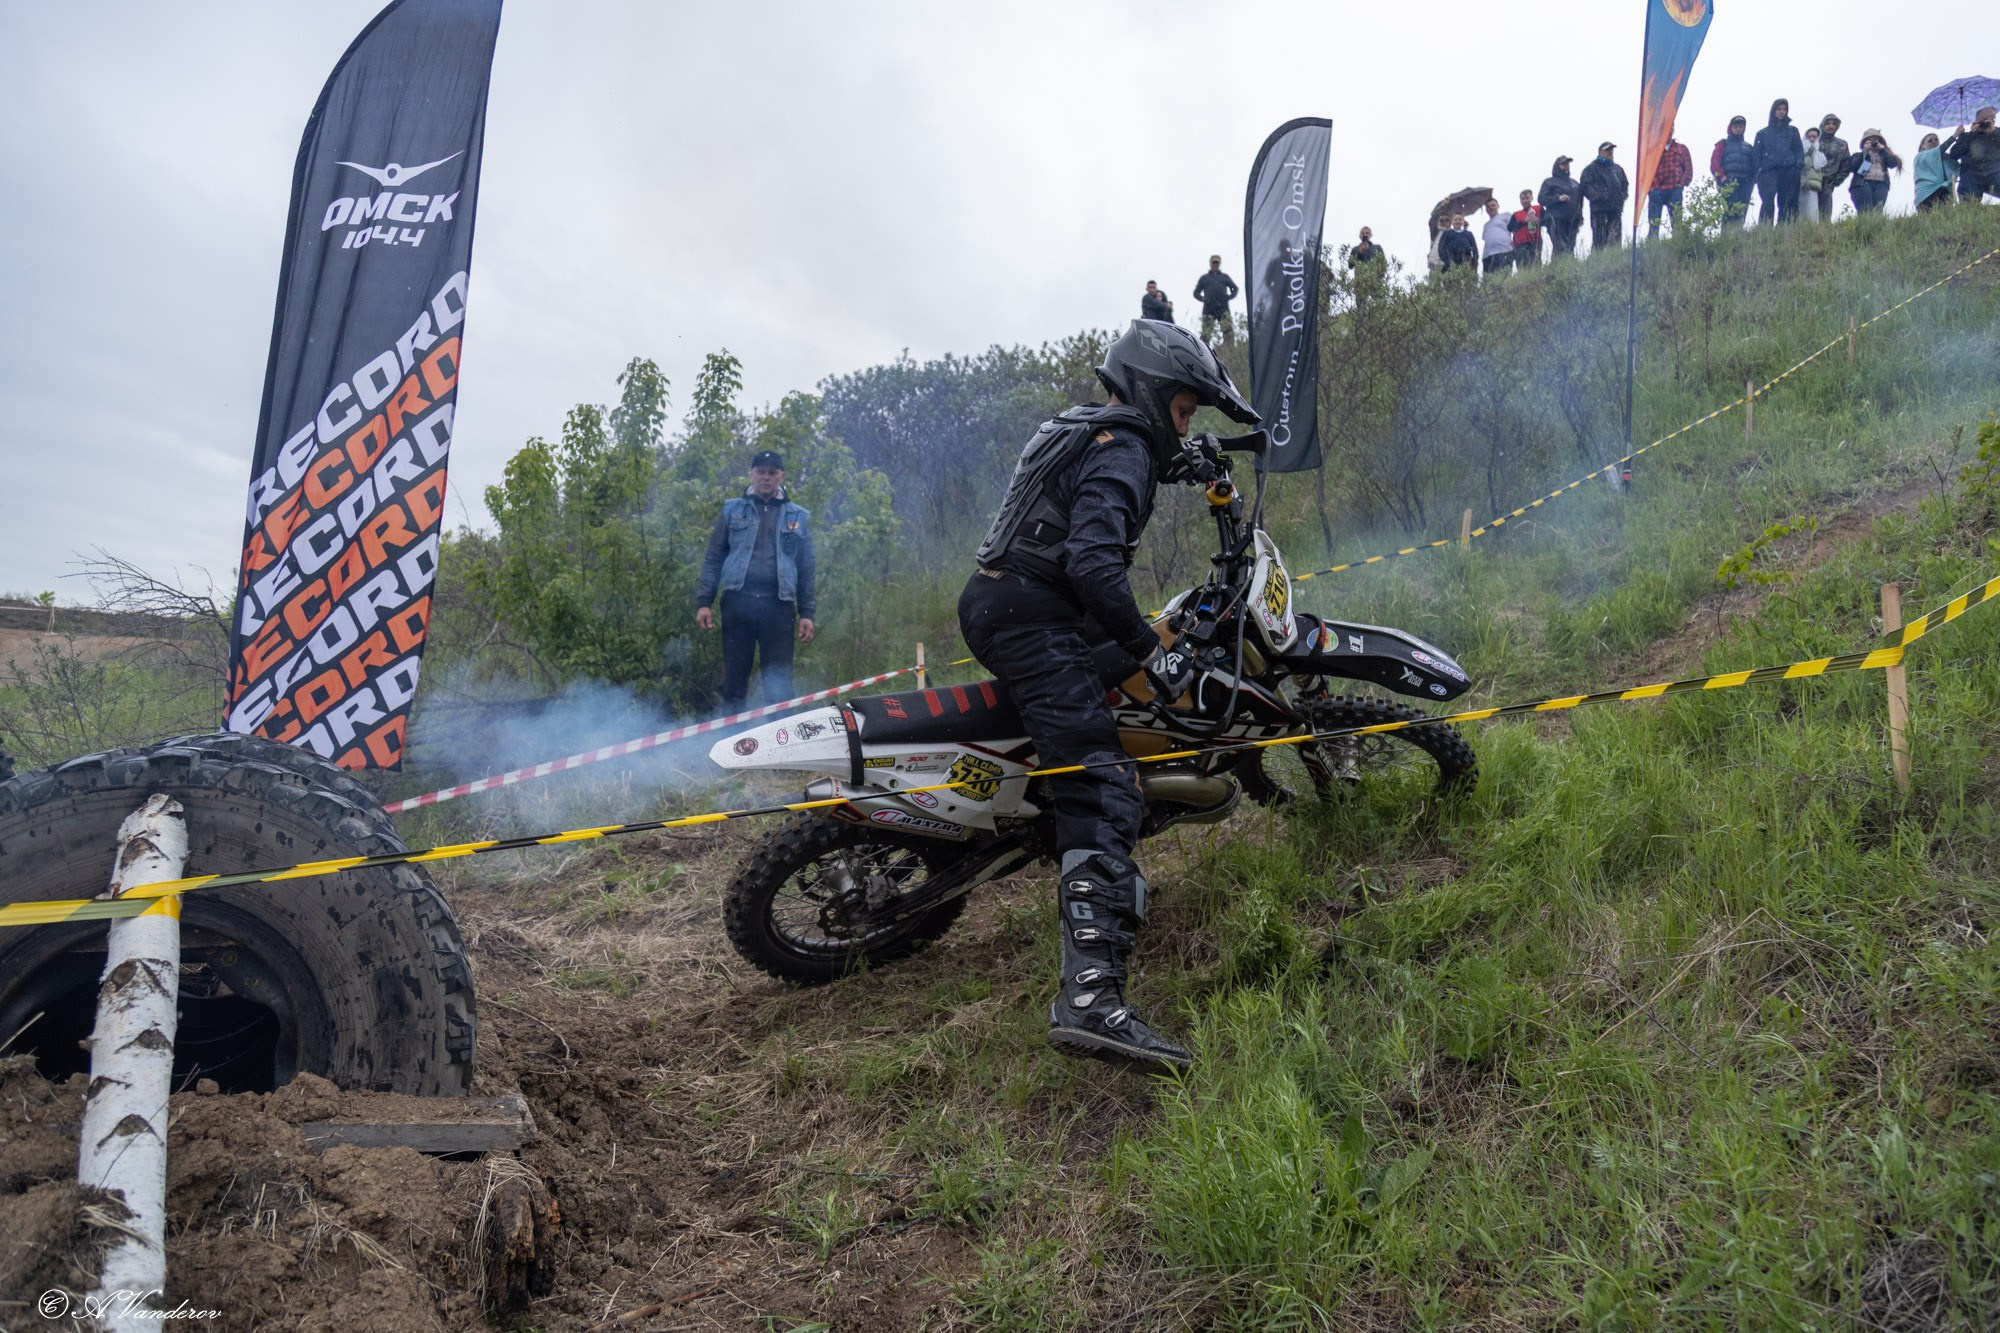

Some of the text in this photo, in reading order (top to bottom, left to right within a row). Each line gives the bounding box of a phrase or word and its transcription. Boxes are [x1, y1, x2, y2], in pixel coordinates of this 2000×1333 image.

[342, 225, 426, 249] 104.4
[246, 271, 469, 528] RECORD
[243, 337, 461, 588] RECORD
[1270, 573, 1285, 610] 710
[963, 754, 980, 767] HILL
[957, 766, 993, 794] 710
